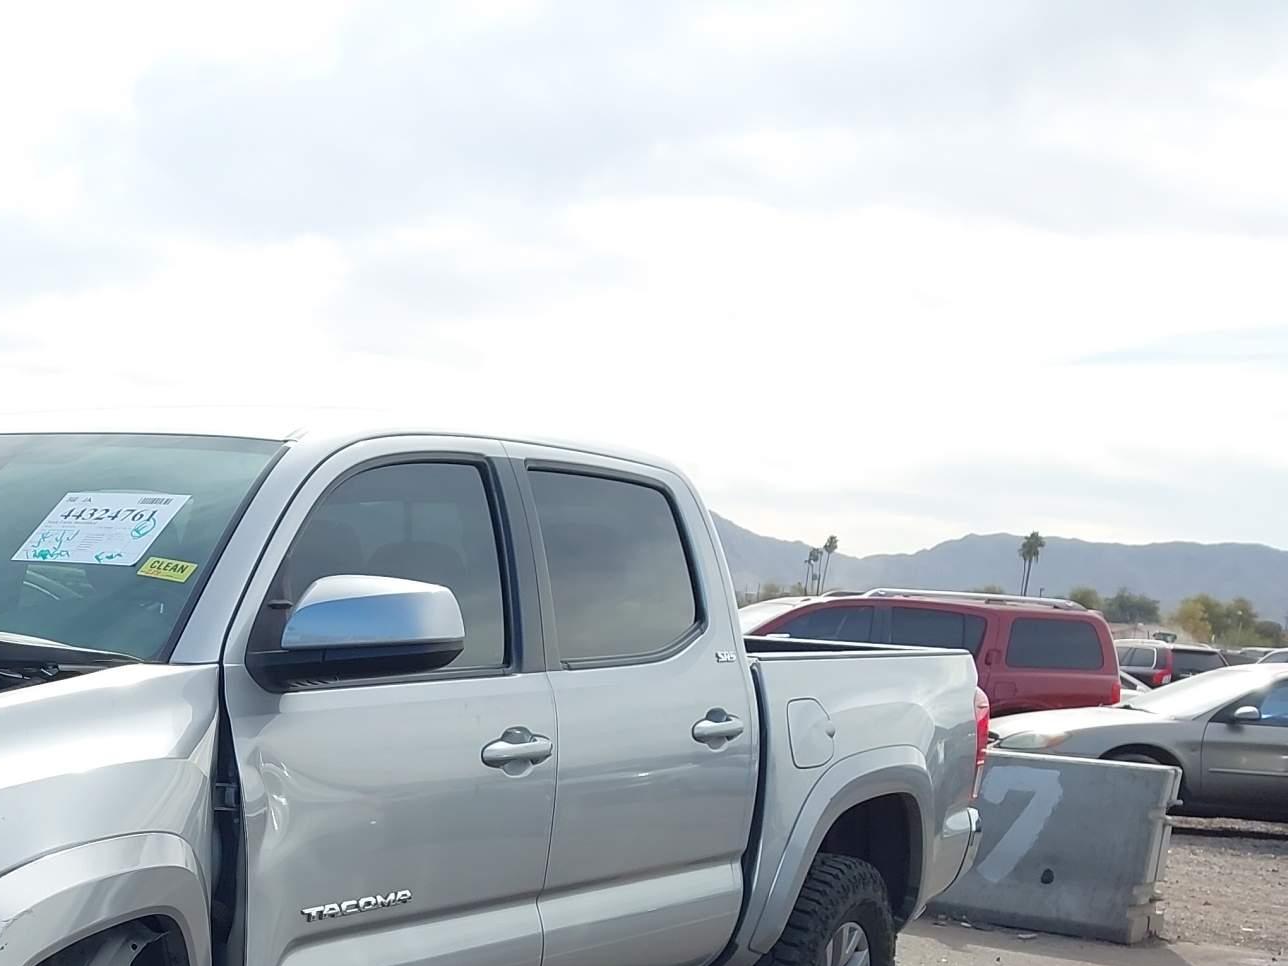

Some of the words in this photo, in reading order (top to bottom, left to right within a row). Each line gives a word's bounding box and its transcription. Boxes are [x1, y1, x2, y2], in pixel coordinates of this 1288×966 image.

[60, 507, 158, 522] 44324761
[149, 560, 189, 574] CLEAN
[976, 766, 1063, 882] 7
[300, 889, 412, 922] TACOMA
